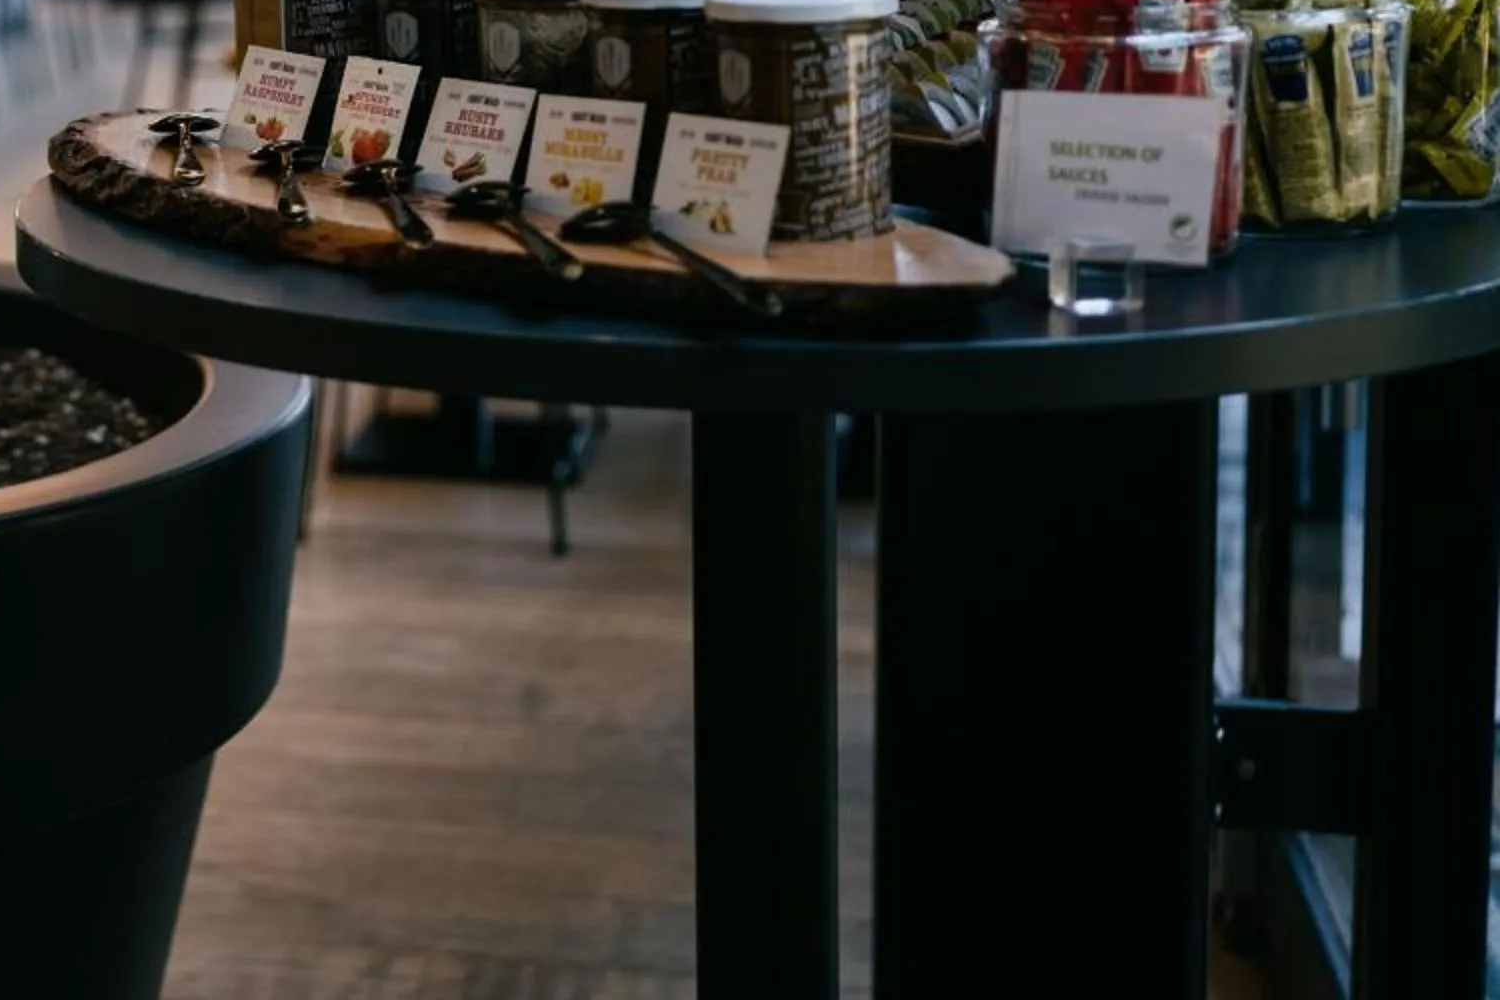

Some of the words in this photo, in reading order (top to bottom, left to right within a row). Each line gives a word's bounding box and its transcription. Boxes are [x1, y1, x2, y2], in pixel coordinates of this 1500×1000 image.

[1050, 138, 1137, 160] SELECTION
[1141, 144, 1164, 163] OF
[1049, 166, 1108, 184] SAUCES
